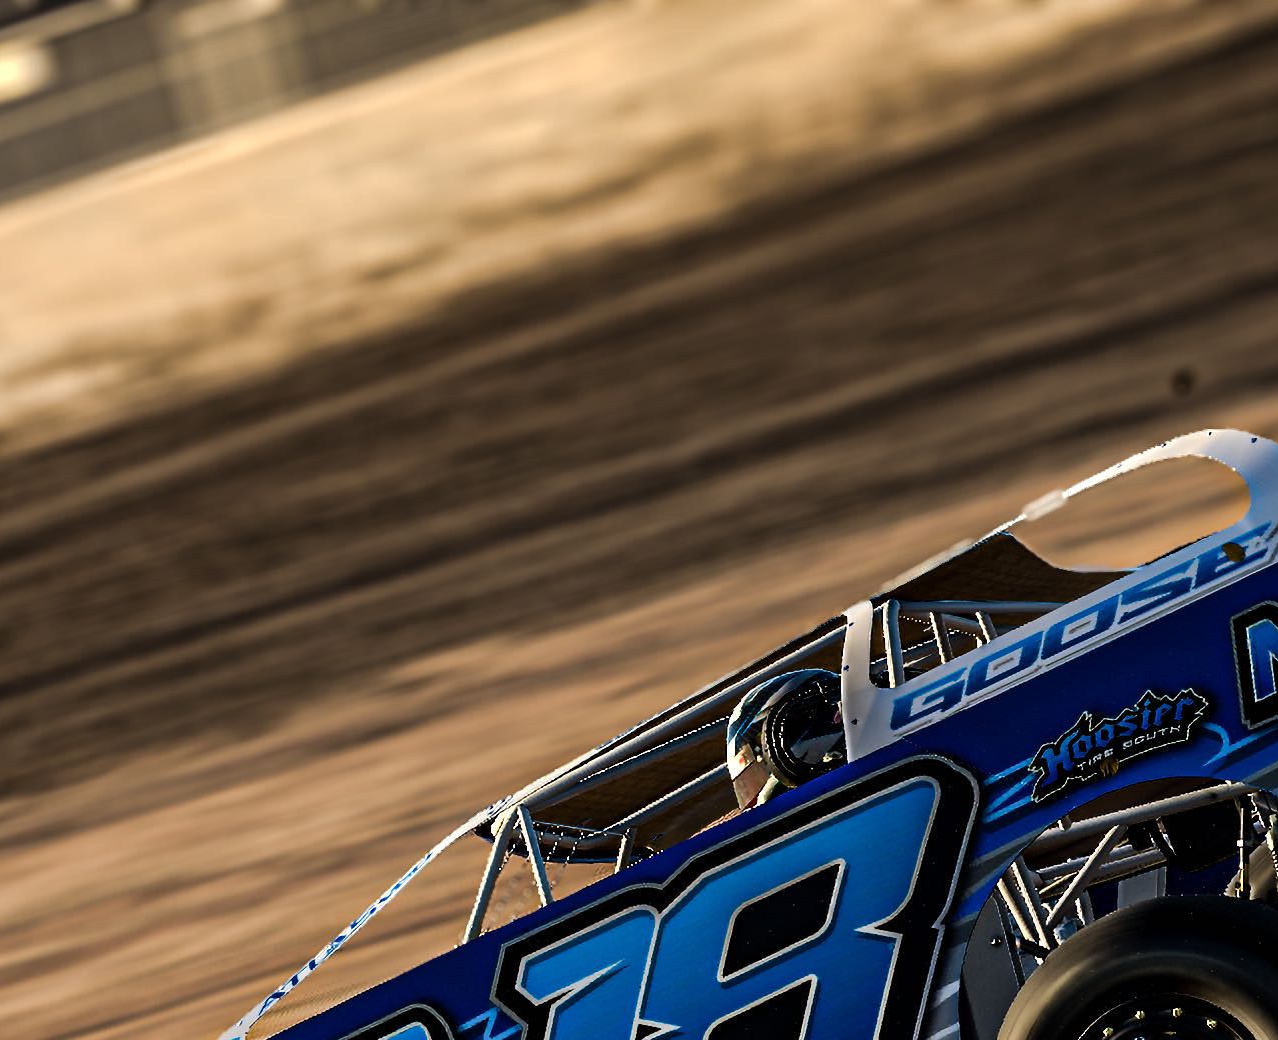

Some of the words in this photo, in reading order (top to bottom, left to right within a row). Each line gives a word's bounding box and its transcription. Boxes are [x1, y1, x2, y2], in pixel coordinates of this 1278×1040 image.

[889, 521, 1273, 731] GOOSE
[1035, 696, 1195, 788] Hoosier
[1123, 723, 1182, 750] SOUTH
